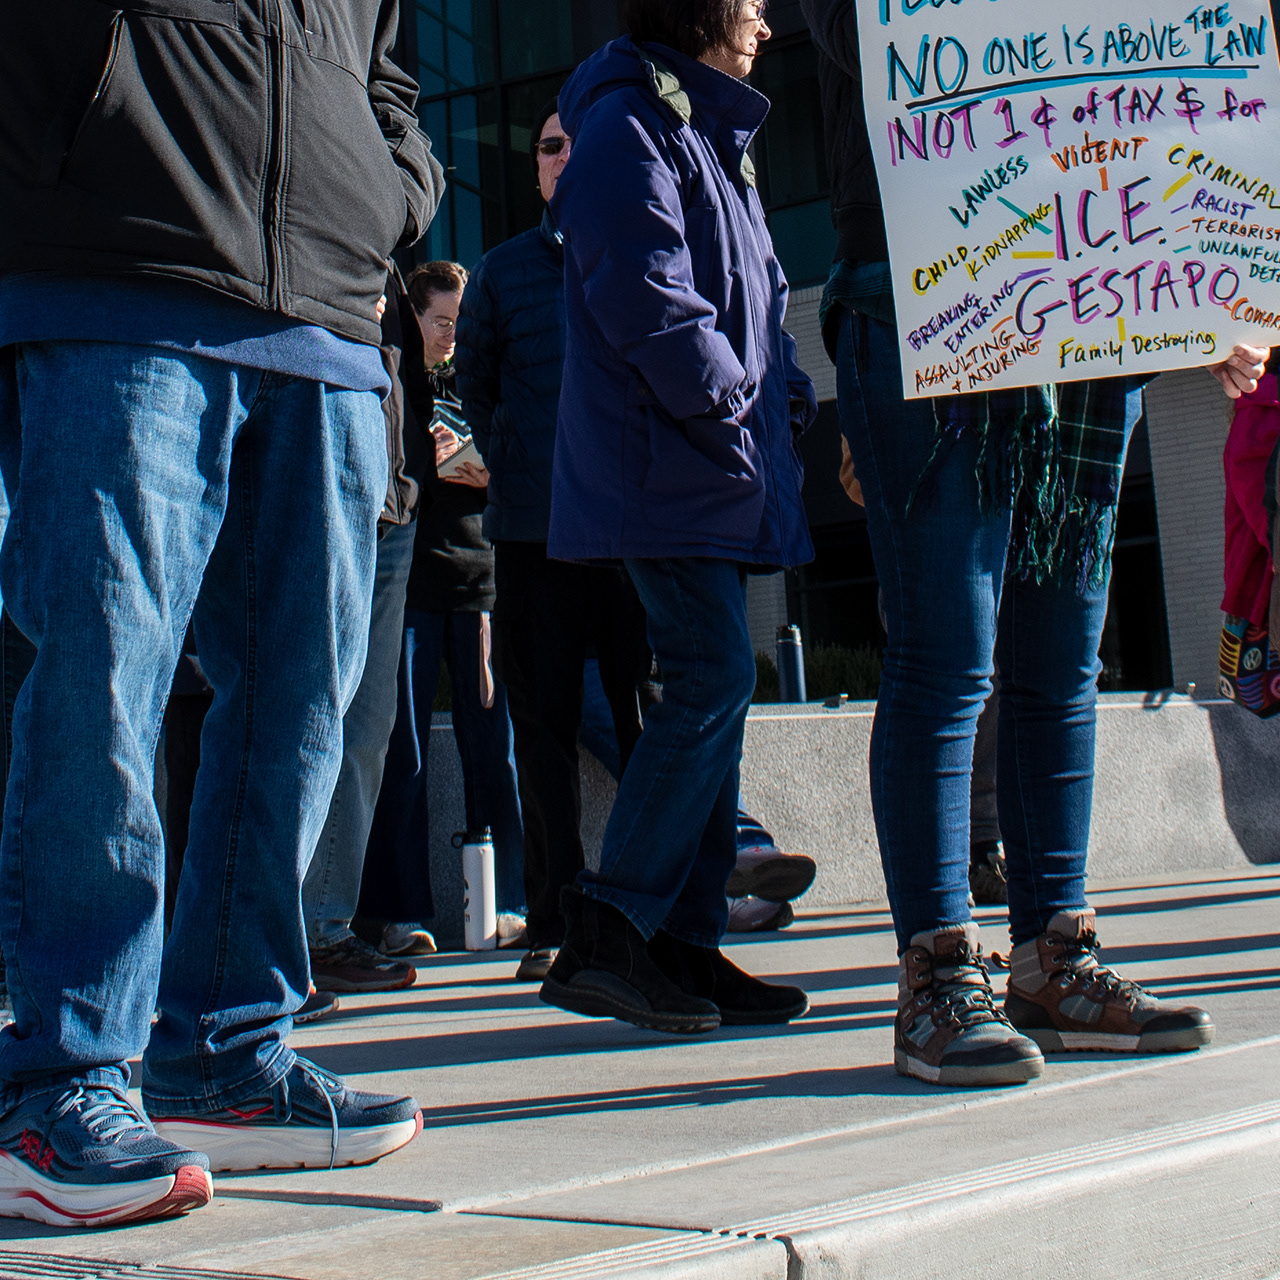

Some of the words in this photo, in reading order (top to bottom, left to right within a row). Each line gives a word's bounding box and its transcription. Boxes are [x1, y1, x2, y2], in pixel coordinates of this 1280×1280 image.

[1061, 24, 1094, 65] IS
[1103, 17, 1187, 65] ABOVE
[1186, 3, 1233, 35] THE
[1204, 14, 1268, 67] LAW
[886, 33, 969, 101] NO
[983, 31, 1055, 75] ONE
[889, 100, 983, 166] NOT
[1072, 87, 1101, 125] of
[1104, 84, 1166, 128] TAX
[1217, 86, 1268, 124] for
[948, 155, 1029, 228] LAWLESS
[1191, 187, 1256, 220] RACIST
[965, 202, 1054, 282] KIDNAPPING
[906, 292, 976, 352] BREAKING
[944, 280, 1019, 354] ENTERING
[1016, 259, 1241, 341] GESTAPO
[915, 329, 1016, 394] ASSAULTING
[968, 337, 1042, 390] INJURING
[1058, 337, 1123, 369] Family
[1130, 329, 1217, 357] Destroying
